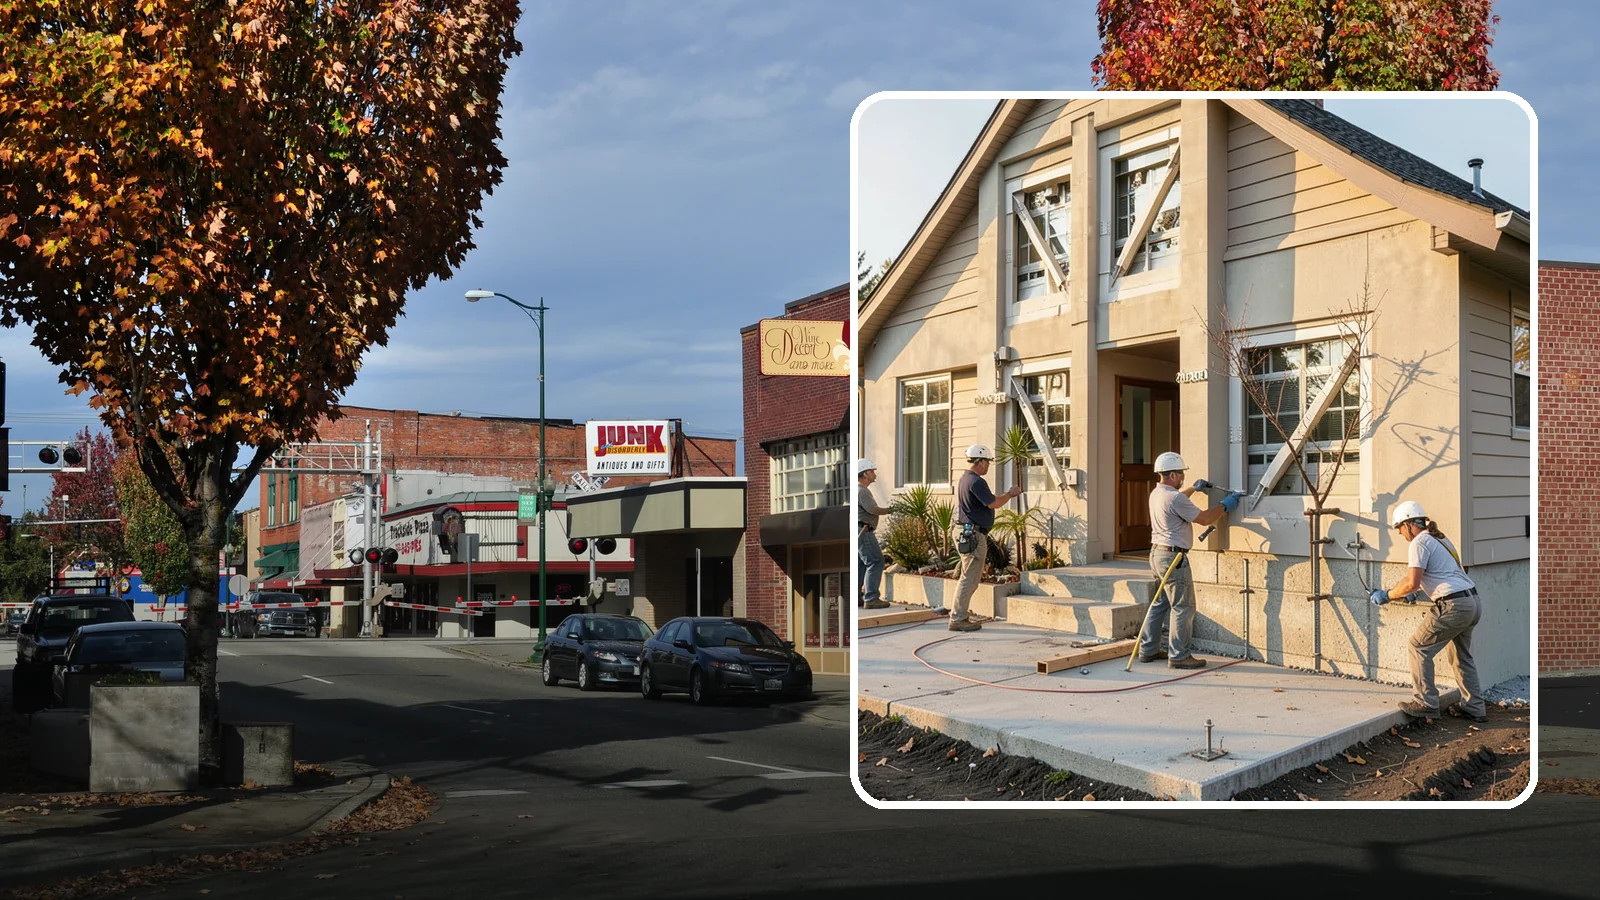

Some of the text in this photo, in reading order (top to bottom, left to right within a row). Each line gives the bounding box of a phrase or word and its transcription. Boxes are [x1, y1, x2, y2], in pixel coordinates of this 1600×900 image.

[595, 425, 665, 457] JUNK
[607, 446, 646, 454] DISORDERLY
[597, 460, 665, 470] ANTIQUES AND GIFTS
[414, 519, 429, 534] Pizza
